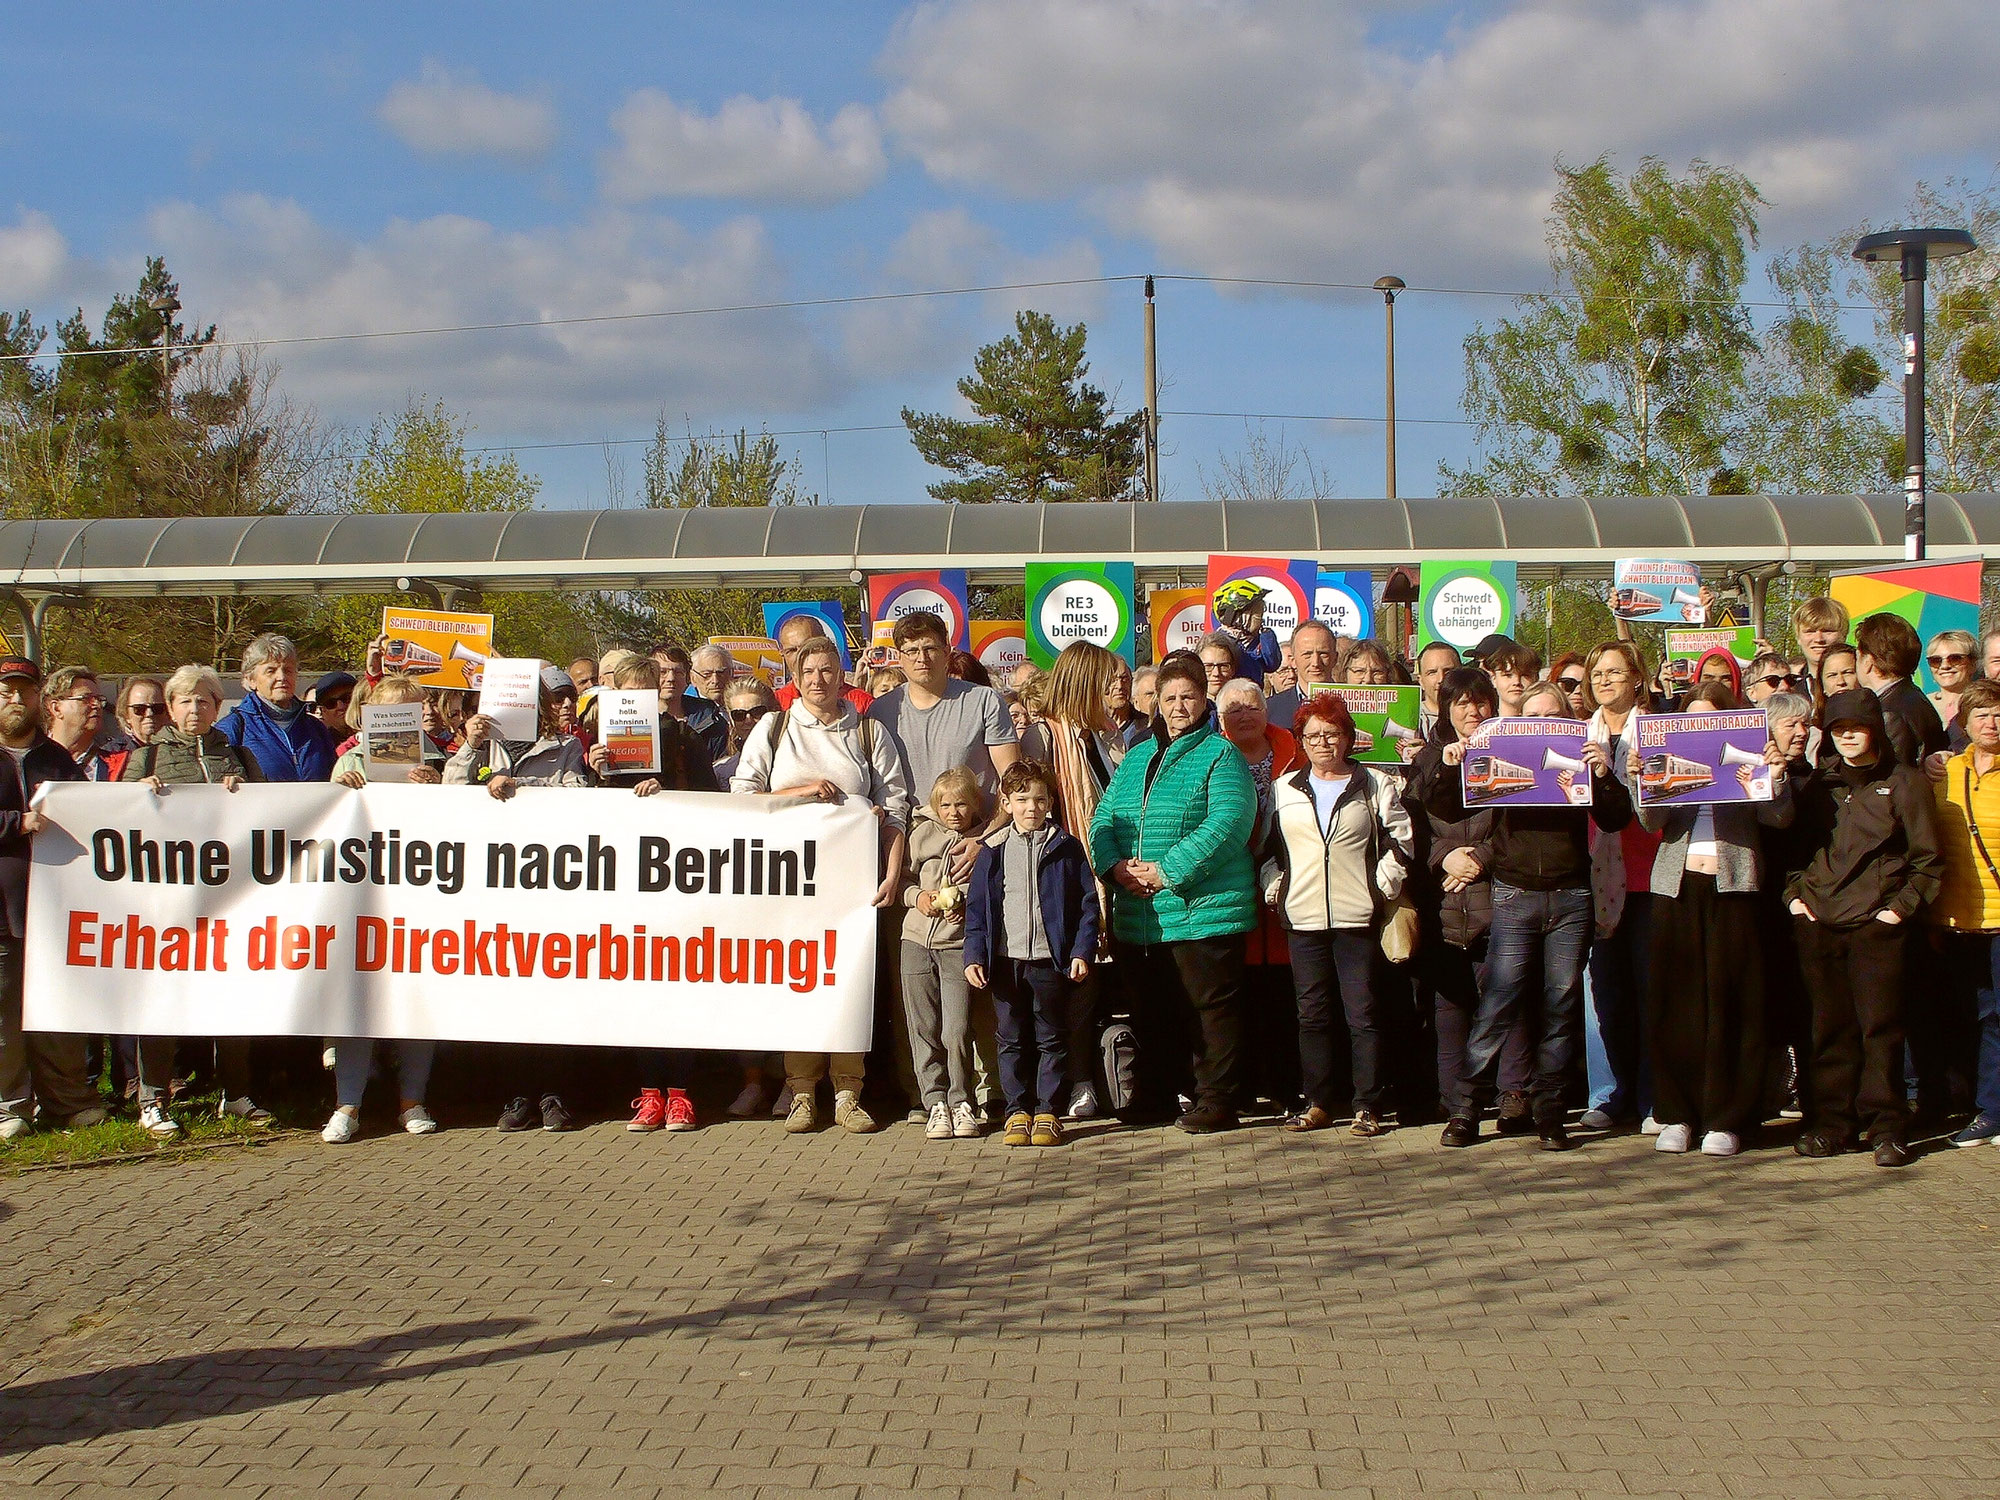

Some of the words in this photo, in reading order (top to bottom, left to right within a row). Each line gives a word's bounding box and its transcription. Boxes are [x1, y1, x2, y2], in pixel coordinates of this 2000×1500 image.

[1443, 592, 1492, 604] Schwedt
[1263, 602, 1292, 615] ollen
[1322, 604, 1349, 617] Zug.
[1453, 604, 1482, 615] nicht
[1061, 613, 1098, 623] muss
[1263, 616, 1296, 628] ahren!
[1439, 616, 1496, 630] abhängen!
[389, 617, 427, 630] SCHWEDT
[428, 619, 454, 633] BLEIBT
[455, 622, 476, 635] DRAN
[1052, 624, 1108, 637] bleiben!
[1181, 620, 1205, 632] Dire
[1719, 631, 1736, 641] GUTE
[999, 650, 1024, 662] Kein
[1377, 690, 1397, 702] GUTE
[389, 711, 413, 719] kommt
[1502, 722, 1543, 736] ZUKUNFT
[1544, 723, 1586, 737] BRAUCHT
[1640, 719, 1676, 734] UNSERE
[1678, 717, 1719, 732] ZUKUNFT
[1722, 714, 1764, 729] BRAUCHT
[610, 747, 637, 755] REGIO
[92, 828, 231, 887] Ohne
[250, 828, 466, 895] Umstieg
[486, 834, 617, 892] nach
[638, 835, 817, 897] Berlin!
[66, 909, 230, 972] Erhalt
[247, 914, 336, 972] der
[354, 914, 838, 994] Direktverbindung!
